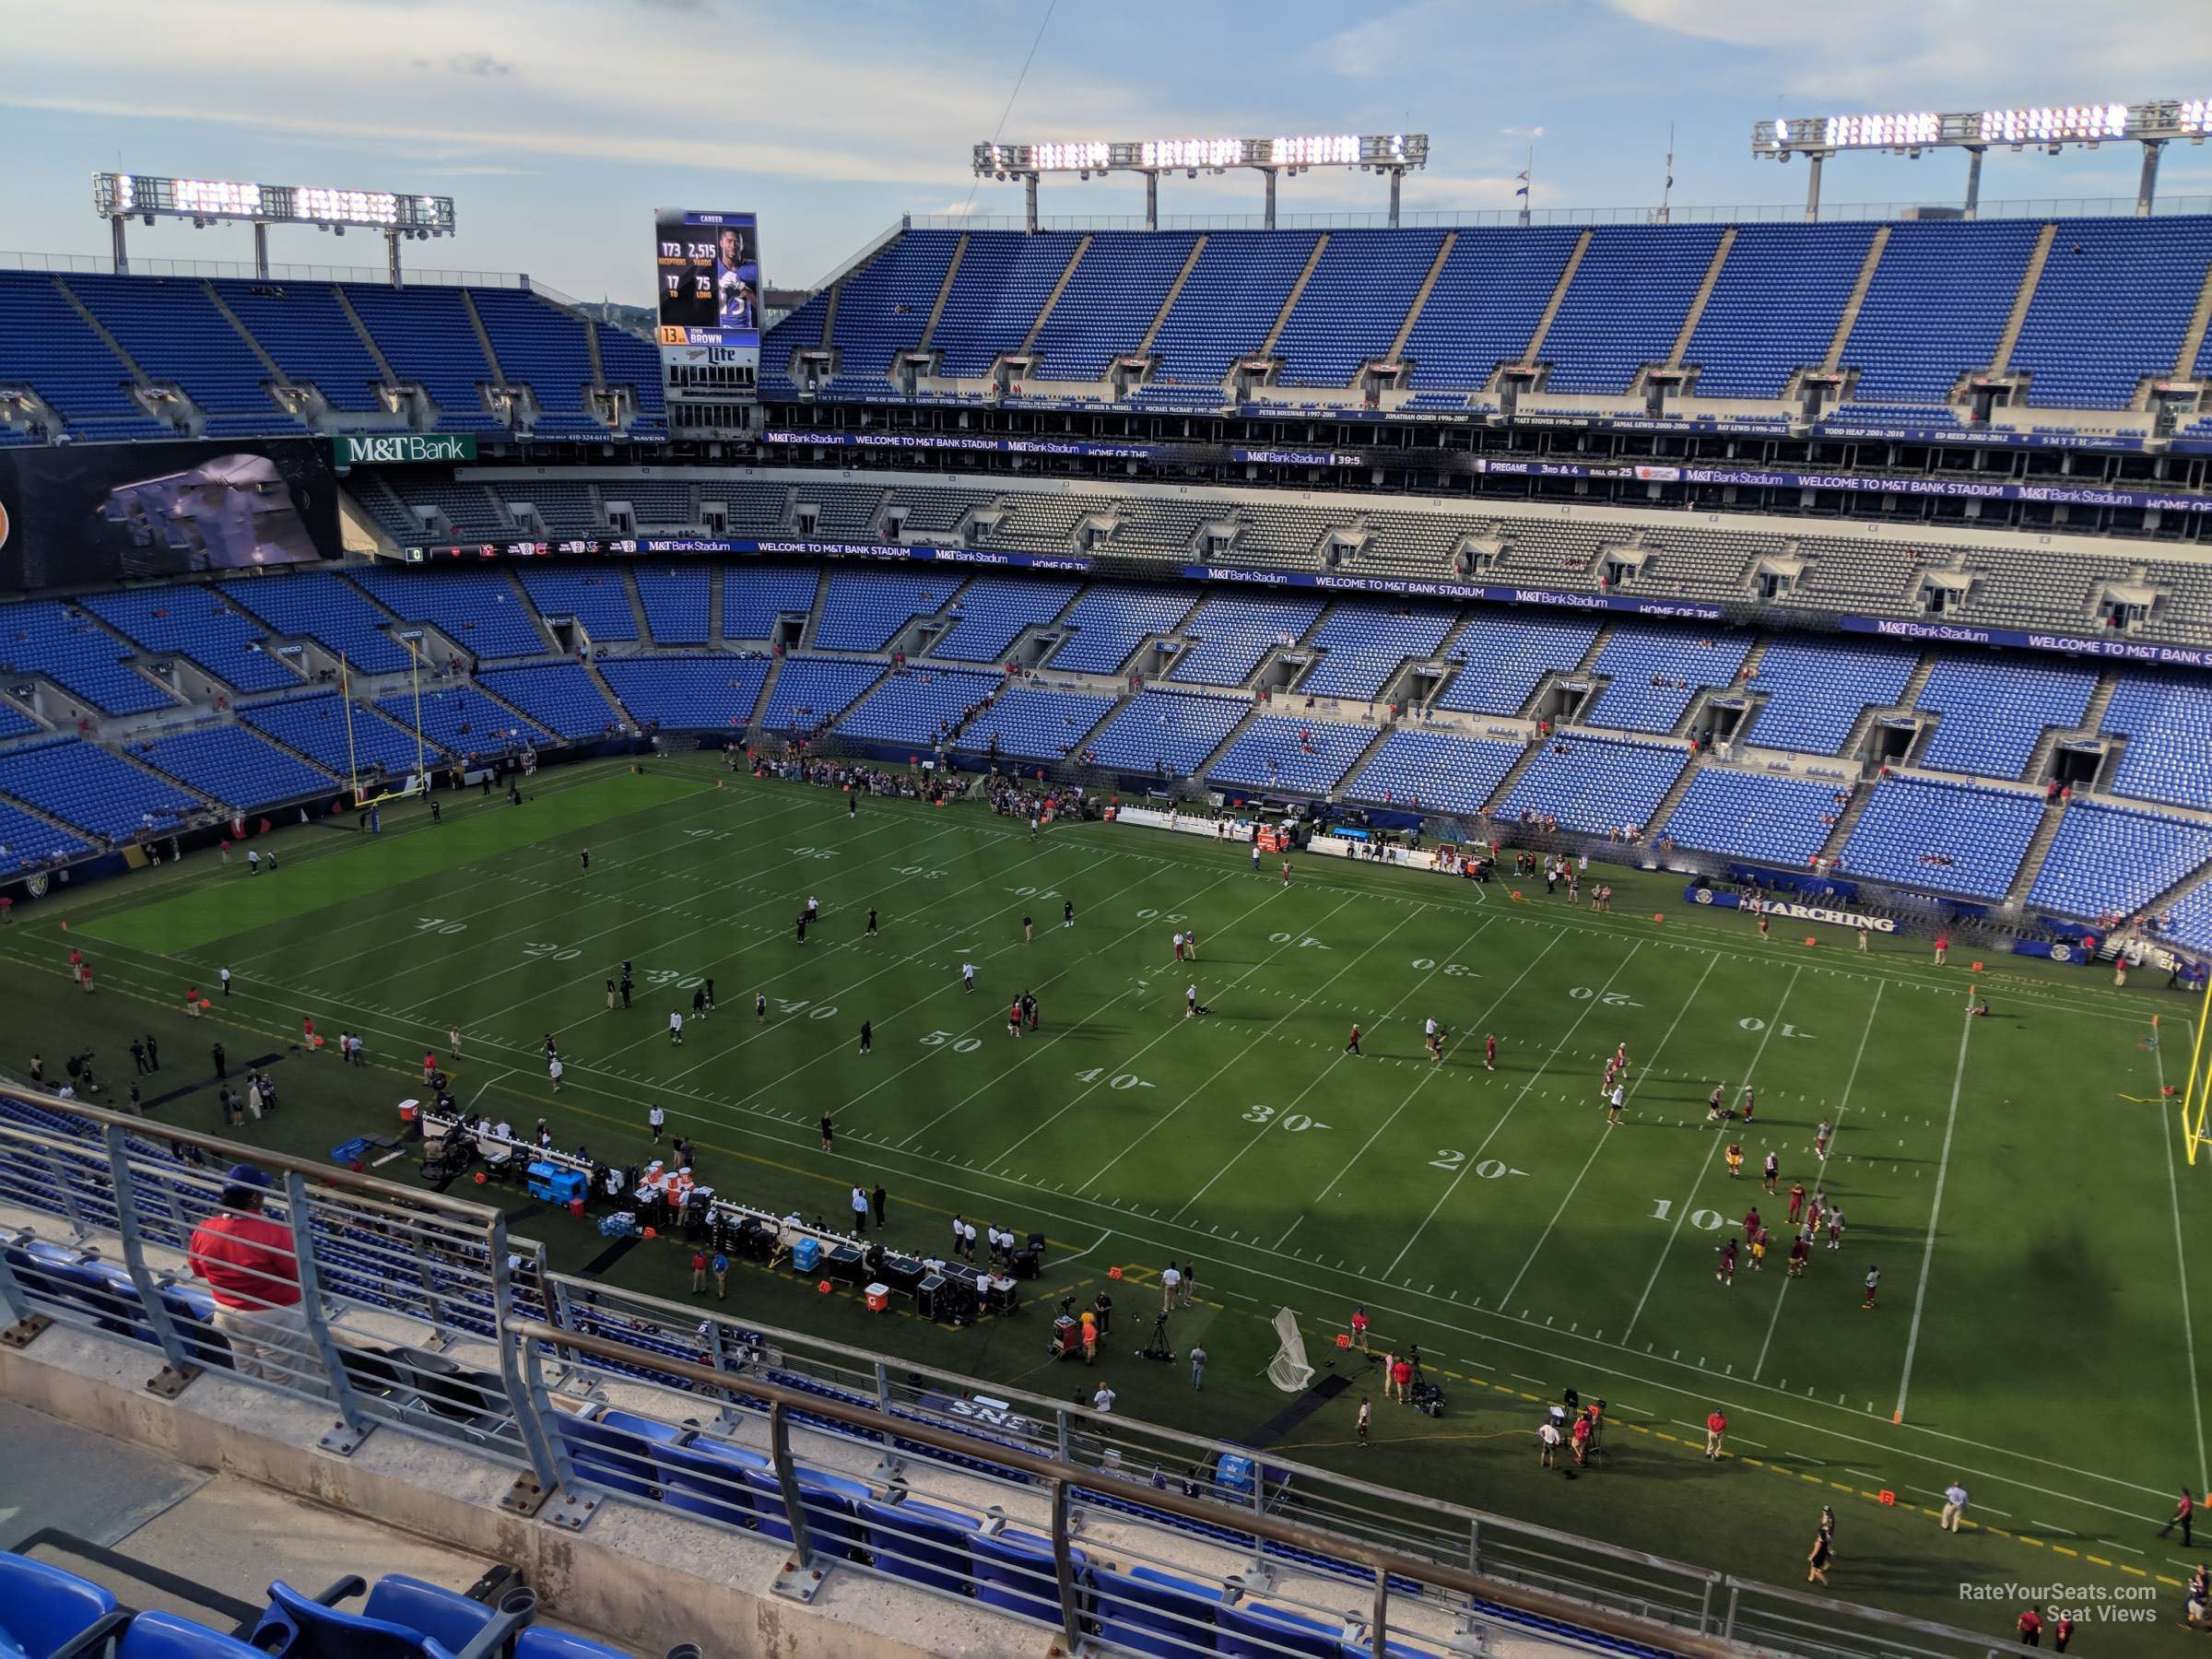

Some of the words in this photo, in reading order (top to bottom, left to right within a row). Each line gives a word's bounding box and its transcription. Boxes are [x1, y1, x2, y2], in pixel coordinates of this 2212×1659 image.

[663, 242, 681, 257] 173
[688, 243, 716, 259] 2,515
[693, 258, 712, 266] YARDS
[667, 276, 679, 289] 17
[696, 276, 711, 290] 75
[664, 328, 677, 343] 13
[691, 335, 723, 344] BROWN
[708, 347, 735, 363] Lite
[769, 433, 790, 442] M&T
[791, 434, 811, 443] Bank
[811, 434, 844, 444] Stadium
[855, 435, 900, 446] WELCOME
[901, 437, 914, 446] TO
[916, 438, 935, 447] M&T
[936, 439, 960, 448] BANK
[962, 439, 997, 450] STADIUM
[1967, 433, 2008, 442] 2002-2012
[2042, 437, 2088, 446] SMYTH
[347, 437, 408, 462] M&T
[410, 437, 465, 461] Bank
[1008, 441, 1029, 451] M&T
[1029, 442, 1047, 452] Bank
[1047, 442, 1078, 453] Stadium
[1247, 452, 1269, 461] M&T
[1270, 453, 1290, 463] Bank
[1290, 453, 1325, 465] Stadium
[1491, 463, 1528, 472] PREGAME
[1541, 465, 1558, 474] 3RD
[1560, 465, 1569, 474] &
[1571, 466, 1579, 475] 4
[1618, 468, 1632, 477] 25
[1687, 470, 1712, 481] M&T
[1713, 472, 1739, 483] Bank
[1740, 472, 1783, 485] Stadium
[1799, 476, 1859, 488] WELCOME
[1862, 478, 1878, 488] TO
[1881, 479, 1909, 490] M&T
[1912, 481, 1946, 492] BANK
[1948, 483, 2004, 496] STADIUM
[2018, 487, 2050, 500] M&T
[2051, 488, 2079, 501] Bank
[2081, 490, 2133, 505] Stadium
[649, 542, 672, 551] M&T
[673, 541, 696, 551] Bank
[697, 541, 730, 551] Stadium
[758, 542, 806, 552] WELCOME
[807, 544, 822, 553] TO
[823, 544, 843, 553] M&T
[845, 544, 869, 554] BANK
[871, 546, 911, 557] STADIUM
[414, 549, 420, 559] 0
[936, 549, 956, 560] M&T
[957, 551, 975, 561] Bank
[975, 552, 1008, 564] Stadium
[1207, 569, 1230, 579] M&T
[1230, 570, 1252, 581] Bank
[1252, 571, 1287, 583] Stadium
[1315, 576, 1364, 588] WELCOME
[1367, 579, 1382, 589] TO
[1384, 581, 1406, 592] M&T
[1408, 582, 1436, 594] BANK
[1438, 584, 1484, 597] STADIUM
[1515, 590, 1541, 603] M&T
[1541, 592, 1566, 605] Bank
[1567, 594, 1607, 608] Stadium
[1877, 620, 1909, 634] M&T
[1910, 623, 1938, 638] Bank
[1938, 625, 1988, 641] Stadium
[2028, 636, 2100, 653] WELCOME
[2103, 641, 2124, 654] TO
[2126, 643, 2159, 657] M&T
[2161, 648, 2201, 664] BANK
[1135, 909, 1188, 924] 50
[1747, 898, 1895, 932] MARCHING
[1268, 933, 1322, 947] 40
[1412, 959, 1470, 976] 30
[1569, 986, 1630, 1006] 20
[780, 1000, 839, 1019] 40
[1738, 1017, 1799, 1038] 10
[919, 1030, 982, 1053] 50
[1075, 1067, 1139, 1089] 40
[1241, 1104, 1312, 1132] 30
[1427, 1148, 1507, 1179] 20
[1646, 1198, 1724, 1230] 10
[868, 1298, 876, 1307] G
[1338, 1336, 1347, 1346] 20
